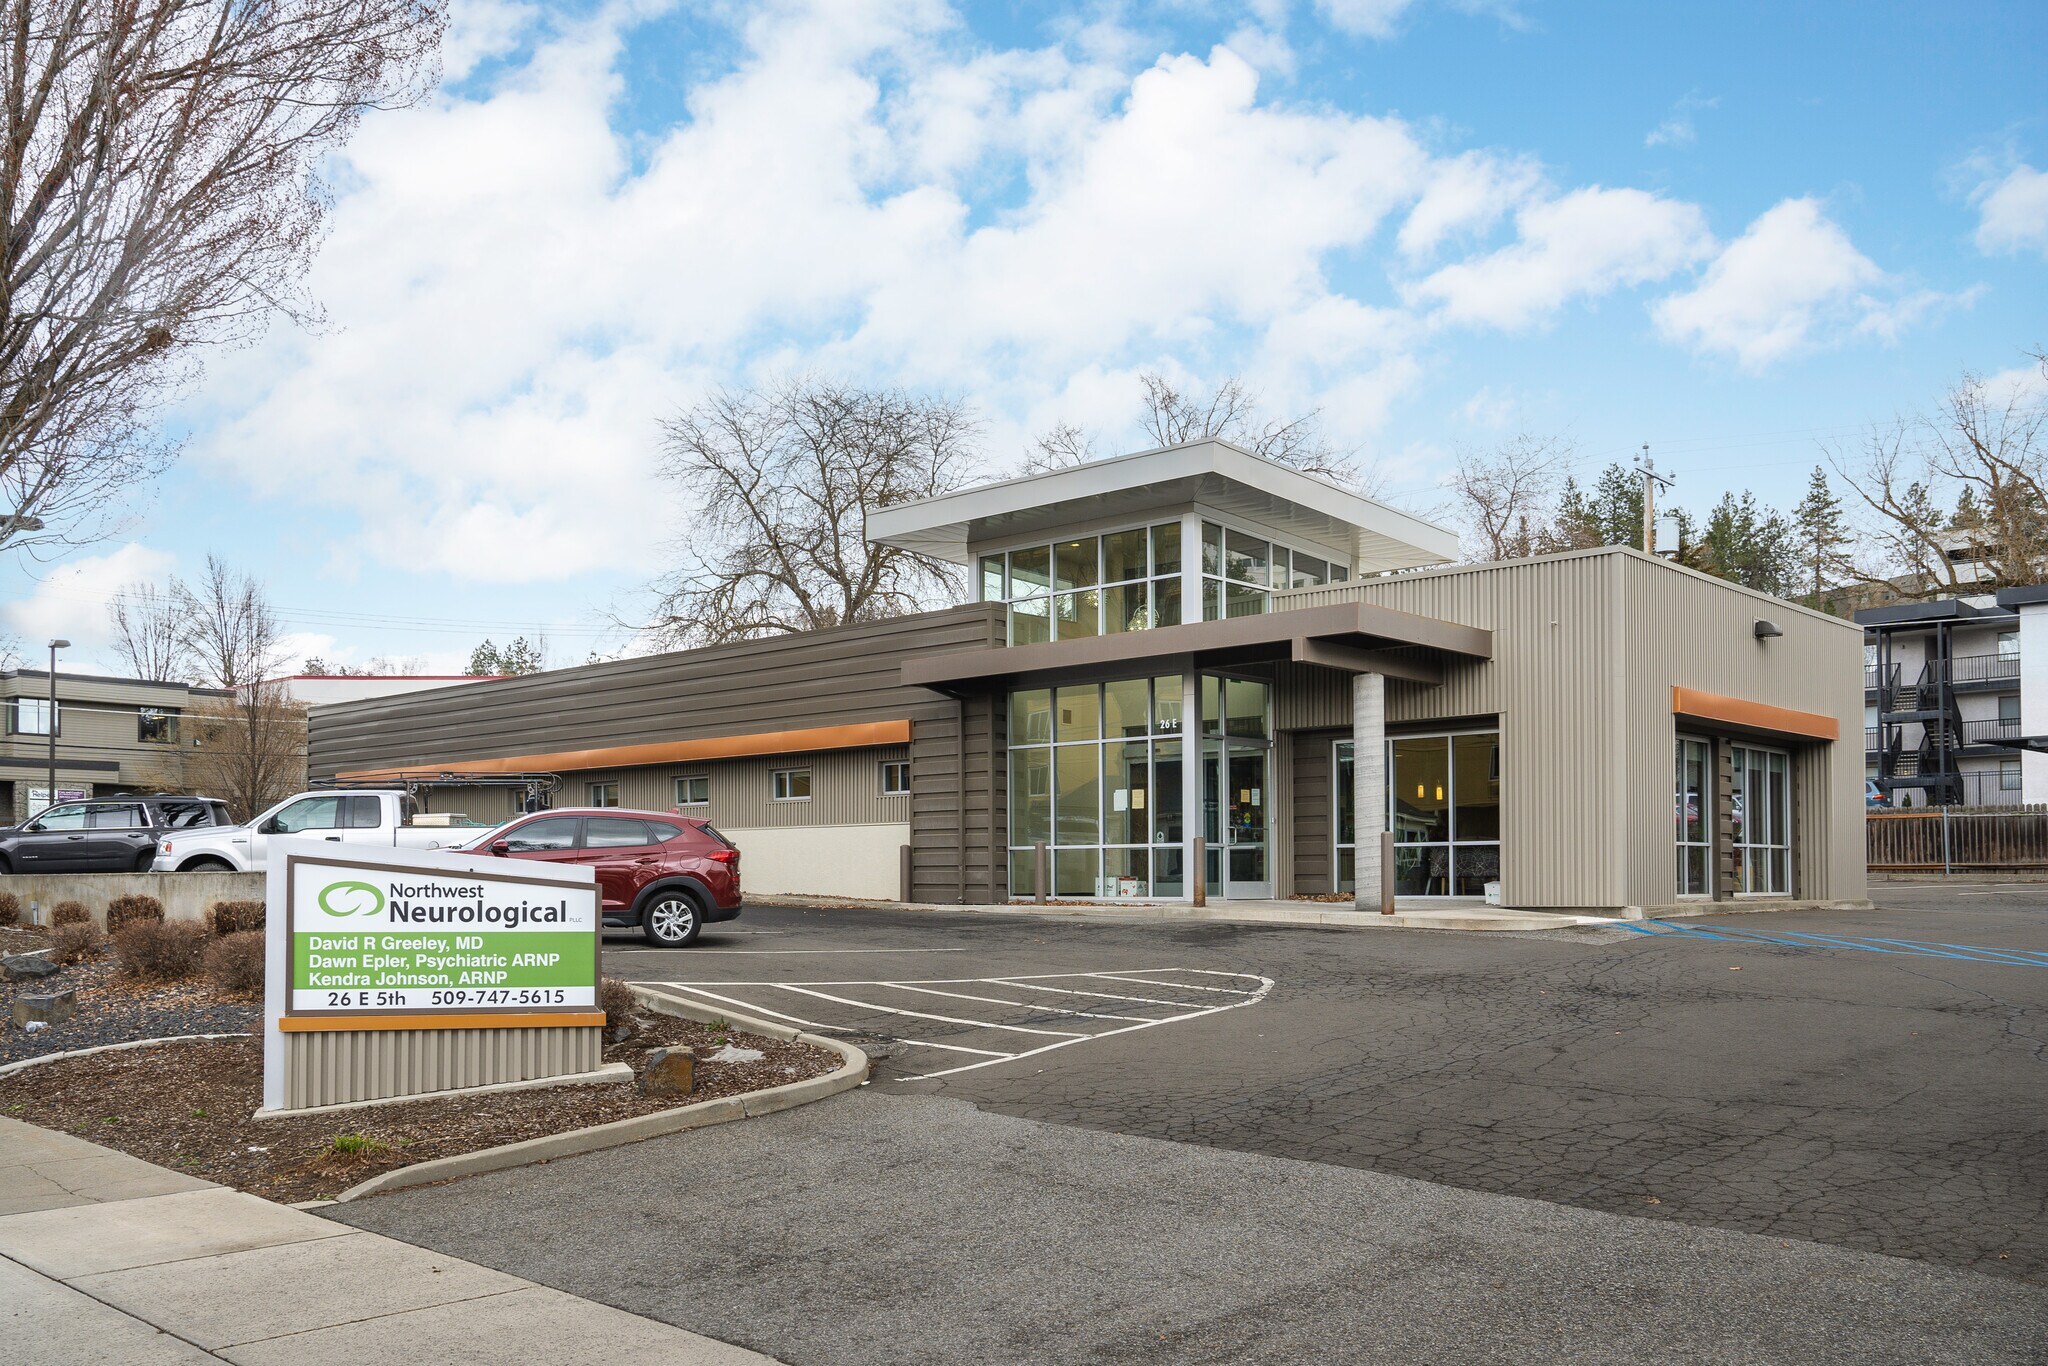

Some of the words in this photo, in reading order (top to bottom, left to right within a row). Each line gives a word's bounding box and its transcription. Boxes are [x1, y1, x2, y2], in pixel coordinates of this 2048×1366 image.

[1160, 719, 1170, 729] 26
[1172, 718, 1177, 728] E
[390, 882, 484, 898] Northwest
[390, 900, 566, 929] Neurological
[309, 936, 358, 951] David
[364, 936, 376, 950] R
[381, 936, 450, 953] Greeley,
[456, 936, 484, 950] MD
[309, 954, 357, 968] Dawn
[362, 954, 410, 971] Epler,
[416, 953, 507, 970] Psychiatric
[511, 953, 560, 967] ARNP
[309, 972, 371, 986] Kendra
[375, 972, 454, 987] Johnson,
[458, 971, 508, 985] ARNP
[328, 992, 351, 1006] 26
[359, 992, 369, 1006] E
[376, 991, 406, 1006] 5th
[431, 990, 565, 1005] 509-747-5615
